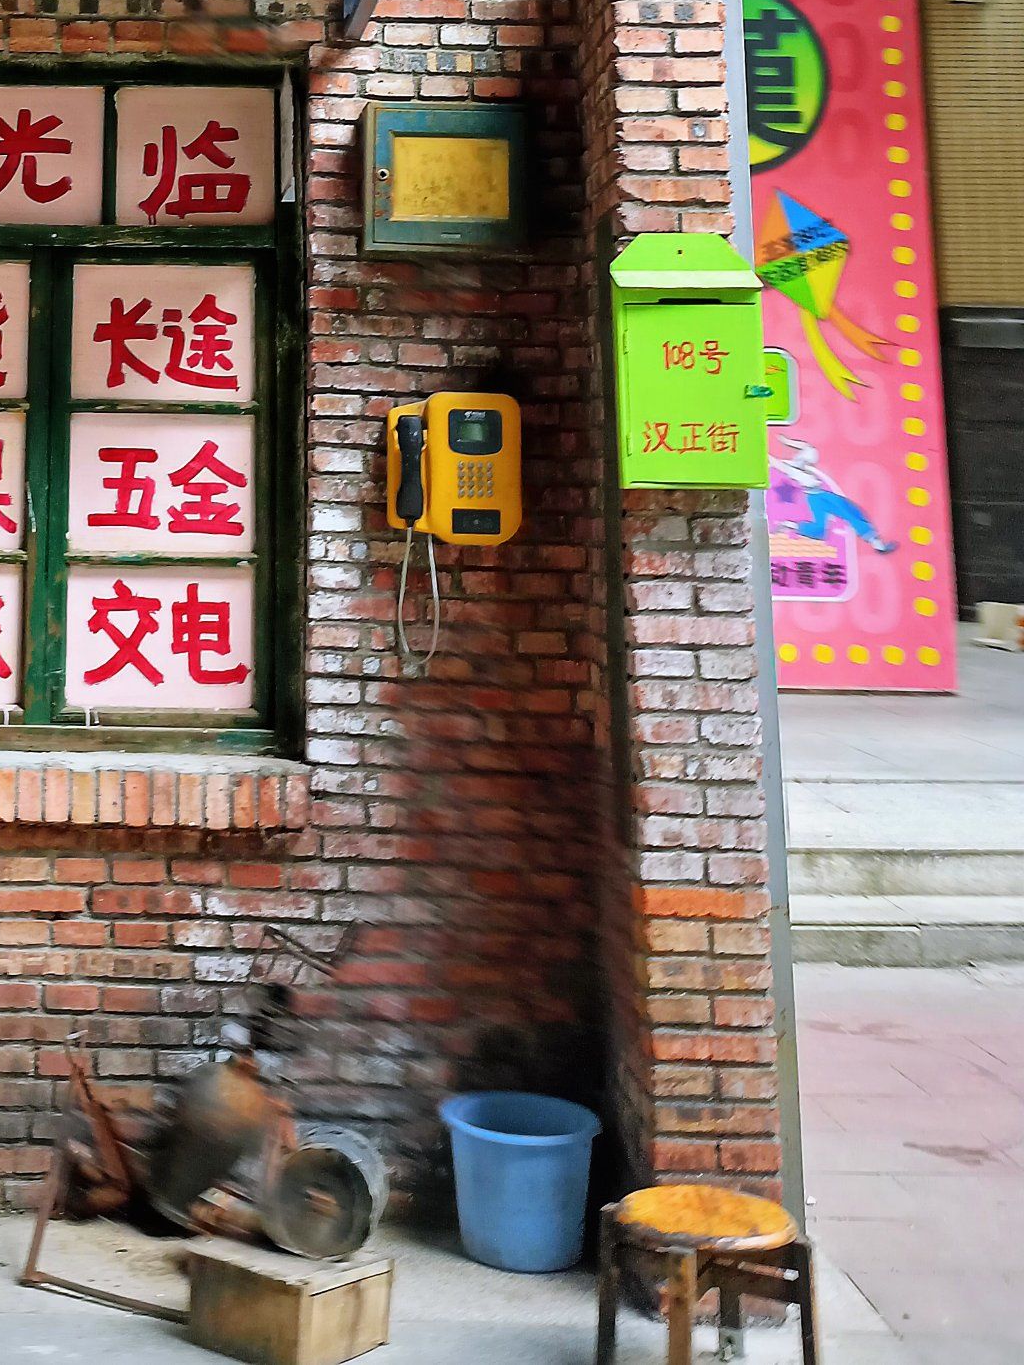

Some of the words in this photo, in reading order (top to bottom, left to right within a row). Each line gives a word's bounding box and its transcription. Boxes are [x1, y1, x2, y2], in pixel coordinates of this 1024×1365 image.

[92, 293, 240, 392] 长途
[662, 340, 730, 375] 108号
[642, 421, 741, 455] 汉正街
[87, 439, 249, 536] 五金
[82, 578, 251, 687] 交电
